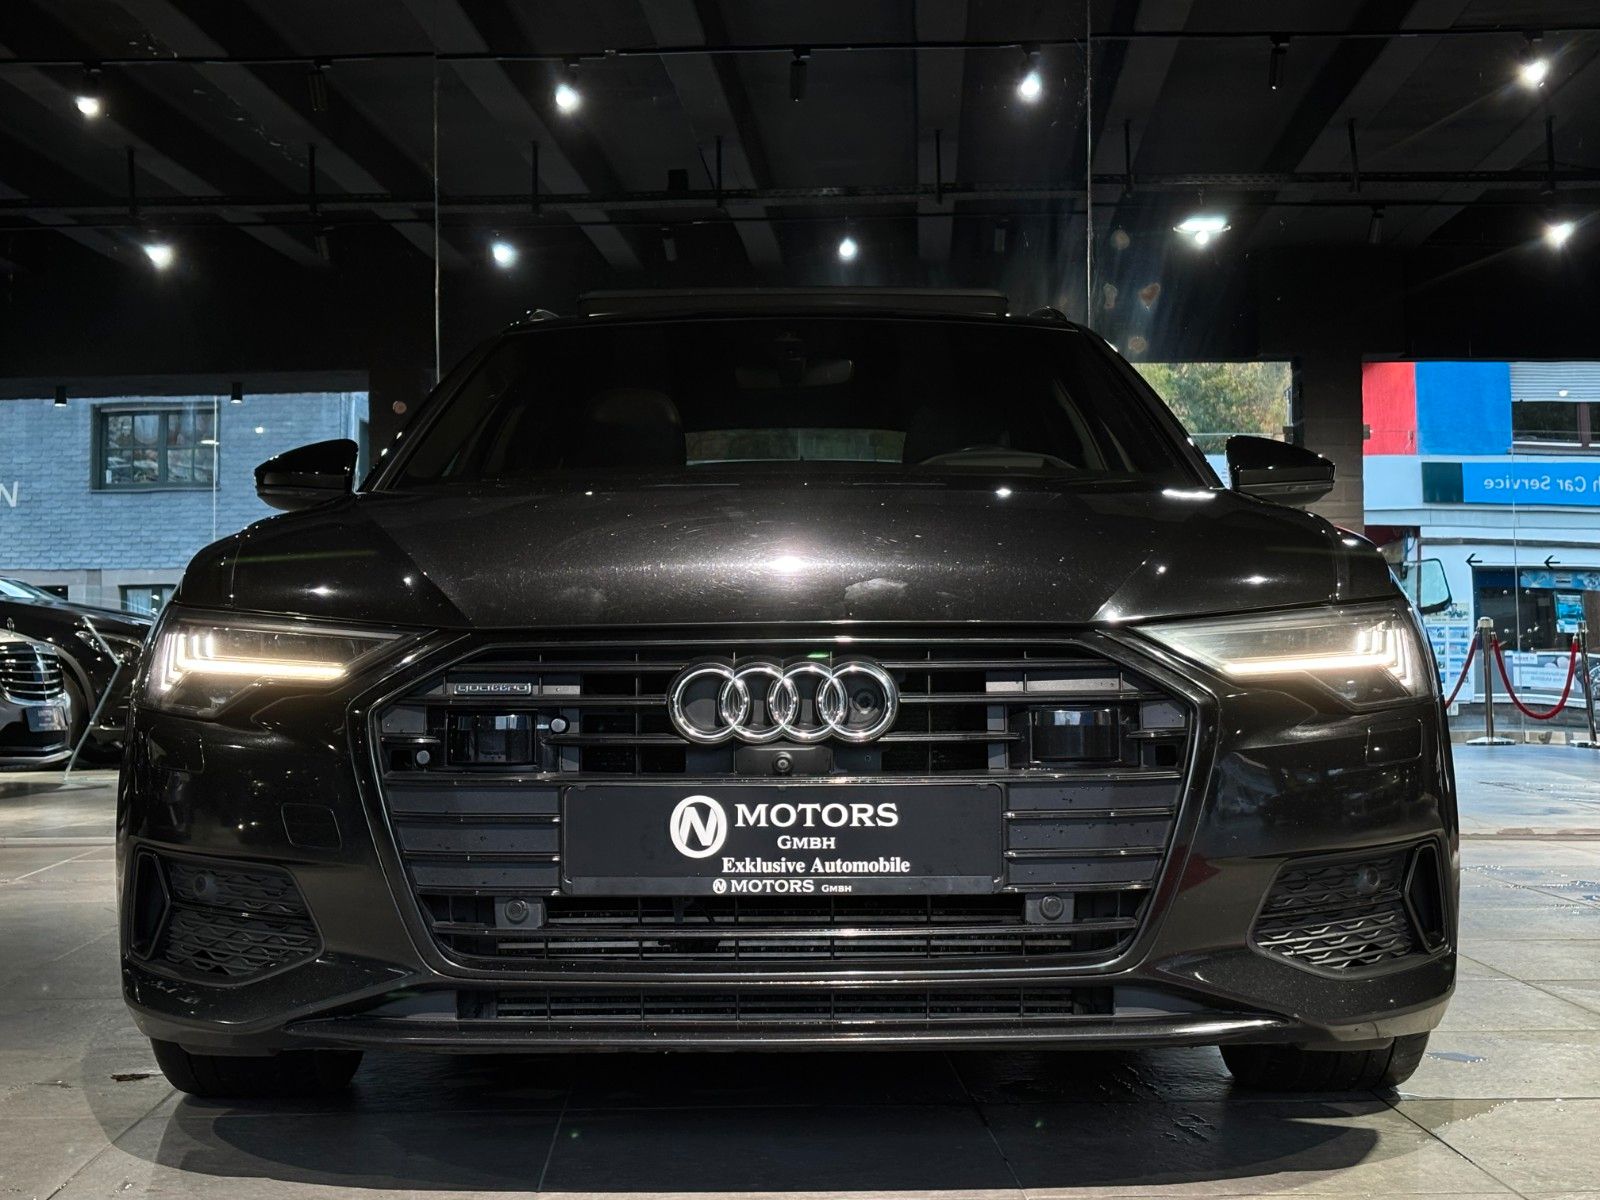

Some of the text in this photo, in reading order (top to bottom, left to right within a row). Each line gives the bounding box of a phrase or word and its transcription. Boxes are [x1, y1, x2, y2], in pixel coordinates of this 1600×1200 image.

[734, 802, 899, 828] MOTORS
[721, 856, 911, 873] Exklusive Automobile
[730, 878, 815, 894] MOTORS
